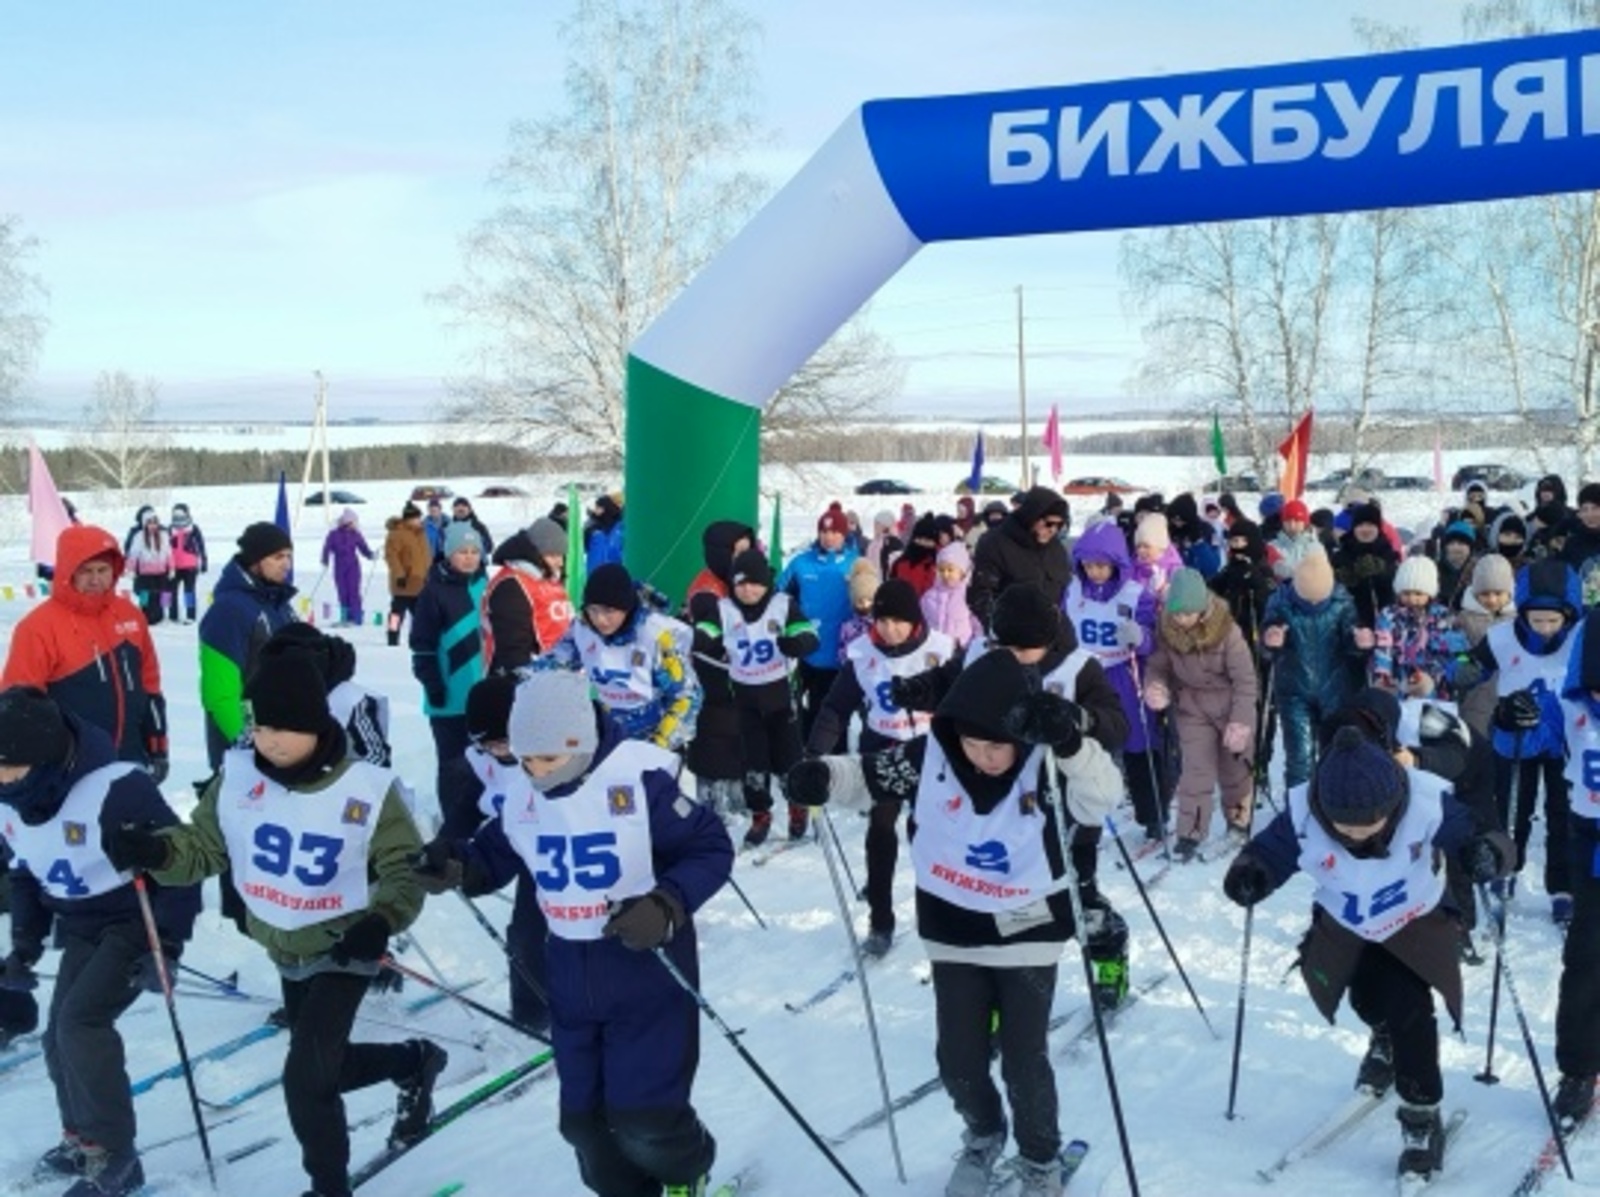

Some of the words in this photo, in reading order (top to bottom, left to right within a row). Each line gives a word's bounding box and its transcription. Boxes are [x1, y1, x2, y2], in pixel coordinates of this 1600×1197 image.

[736, 639, 775, 667] 79
[1080, 618, 1118, 647] 62
[252, 822, 345, 887] 93
[535, 831, 622, 892] 35
[964, 839, 1011, 875] 2
[1341, 878, 1408, 926] 12
